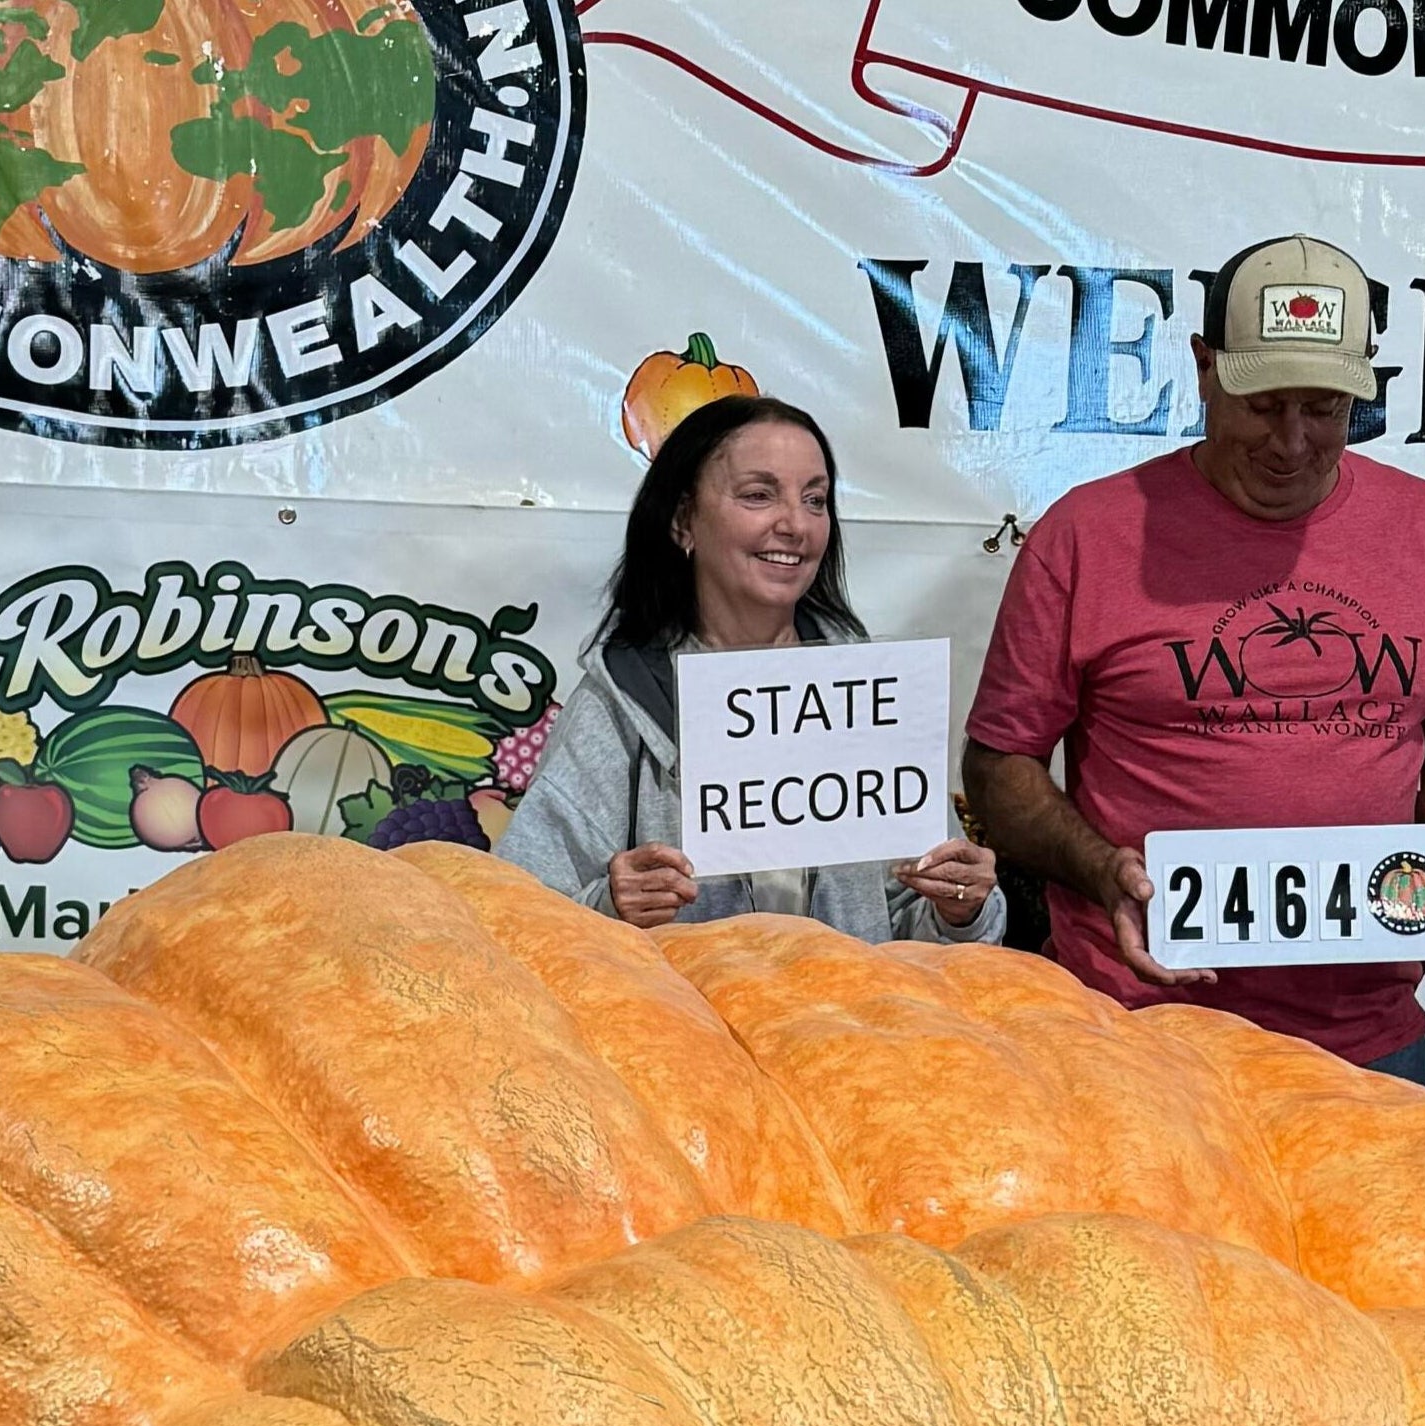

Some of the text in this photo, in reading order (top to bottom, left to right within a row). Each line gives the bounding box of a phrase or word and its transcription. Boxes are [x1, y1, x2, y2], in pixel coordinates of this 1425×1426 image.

[1213, 580, 1380, 634] GROW LIKE A CHAMPION
[726, 676, 898, 739] STATE
[1184, 721, 1299, 736] ORGANIC
[1196, 700, 1405, 724] WALLACE
[700, 765, 929, 833] RECORD
[1169, 863, 1357, 941] 2464
